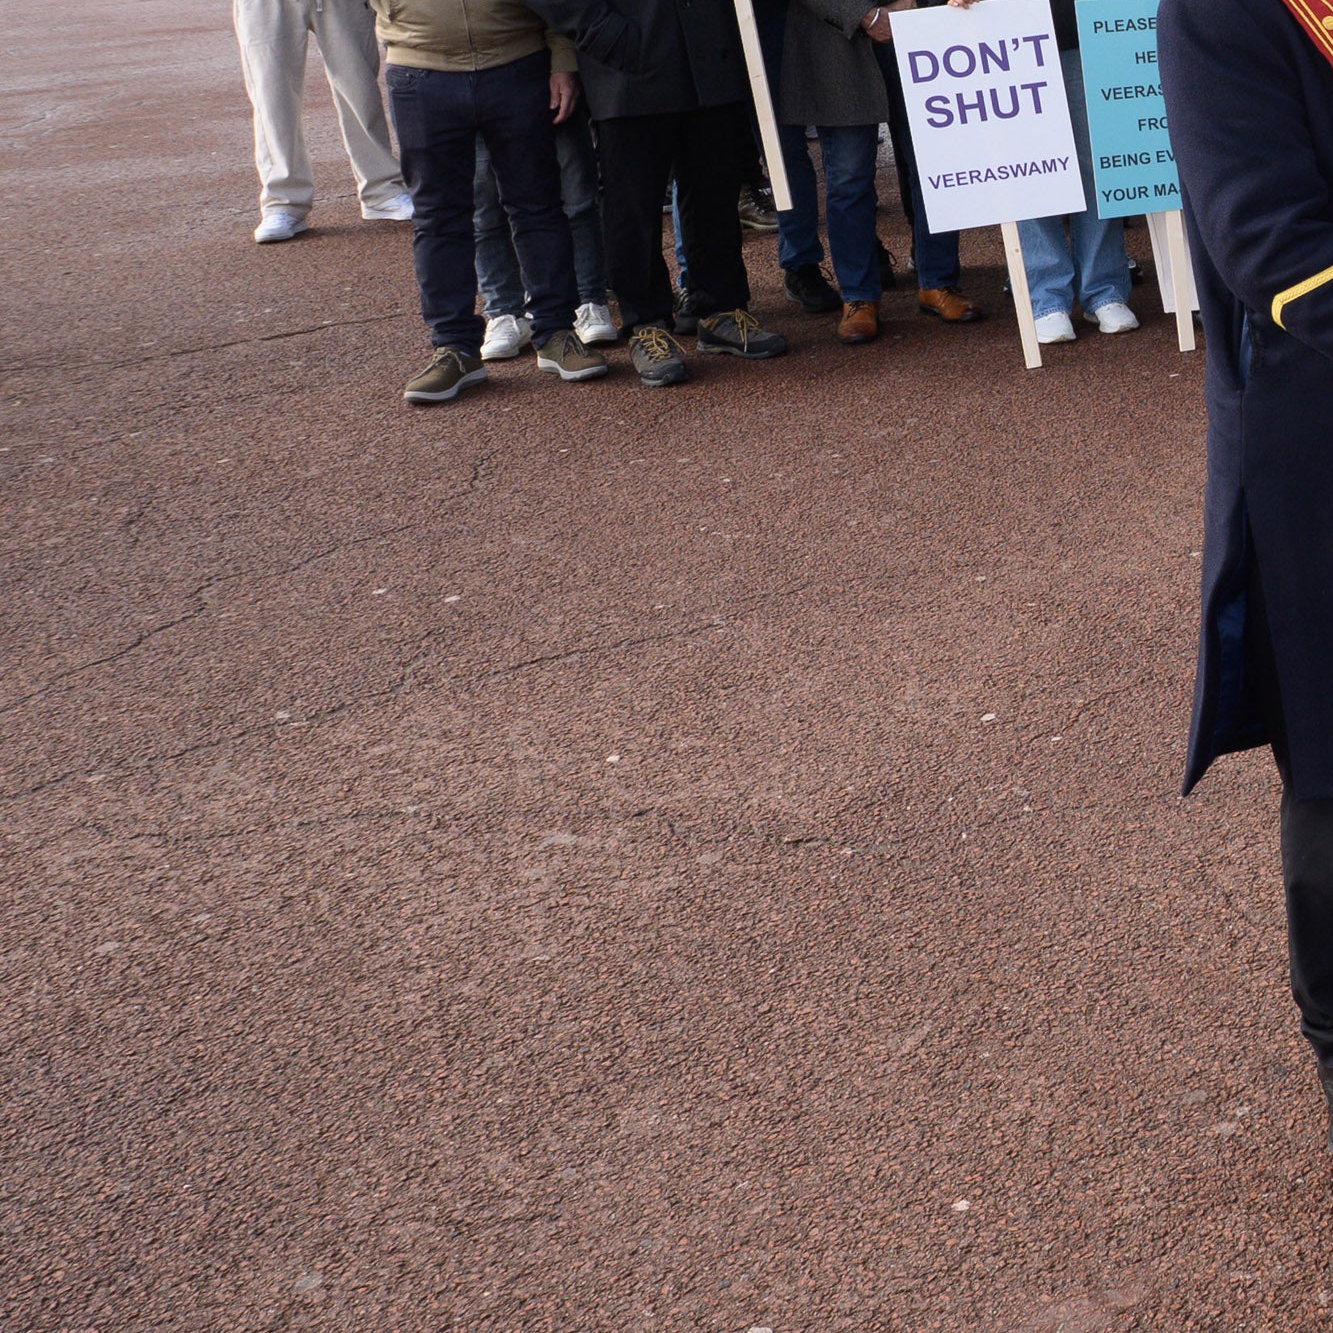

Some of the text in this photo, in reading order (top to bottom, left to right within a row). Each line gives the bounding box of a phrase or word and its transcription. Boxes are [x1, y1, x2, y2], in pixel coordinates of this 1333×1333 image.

[925, 82, 1047, 128] SHUT
[1100, 152, 1150, 169] BEING
[928, 157, 1069, 189] VEERASWAMY
[1102, 186, 1149, 202] YOUR
